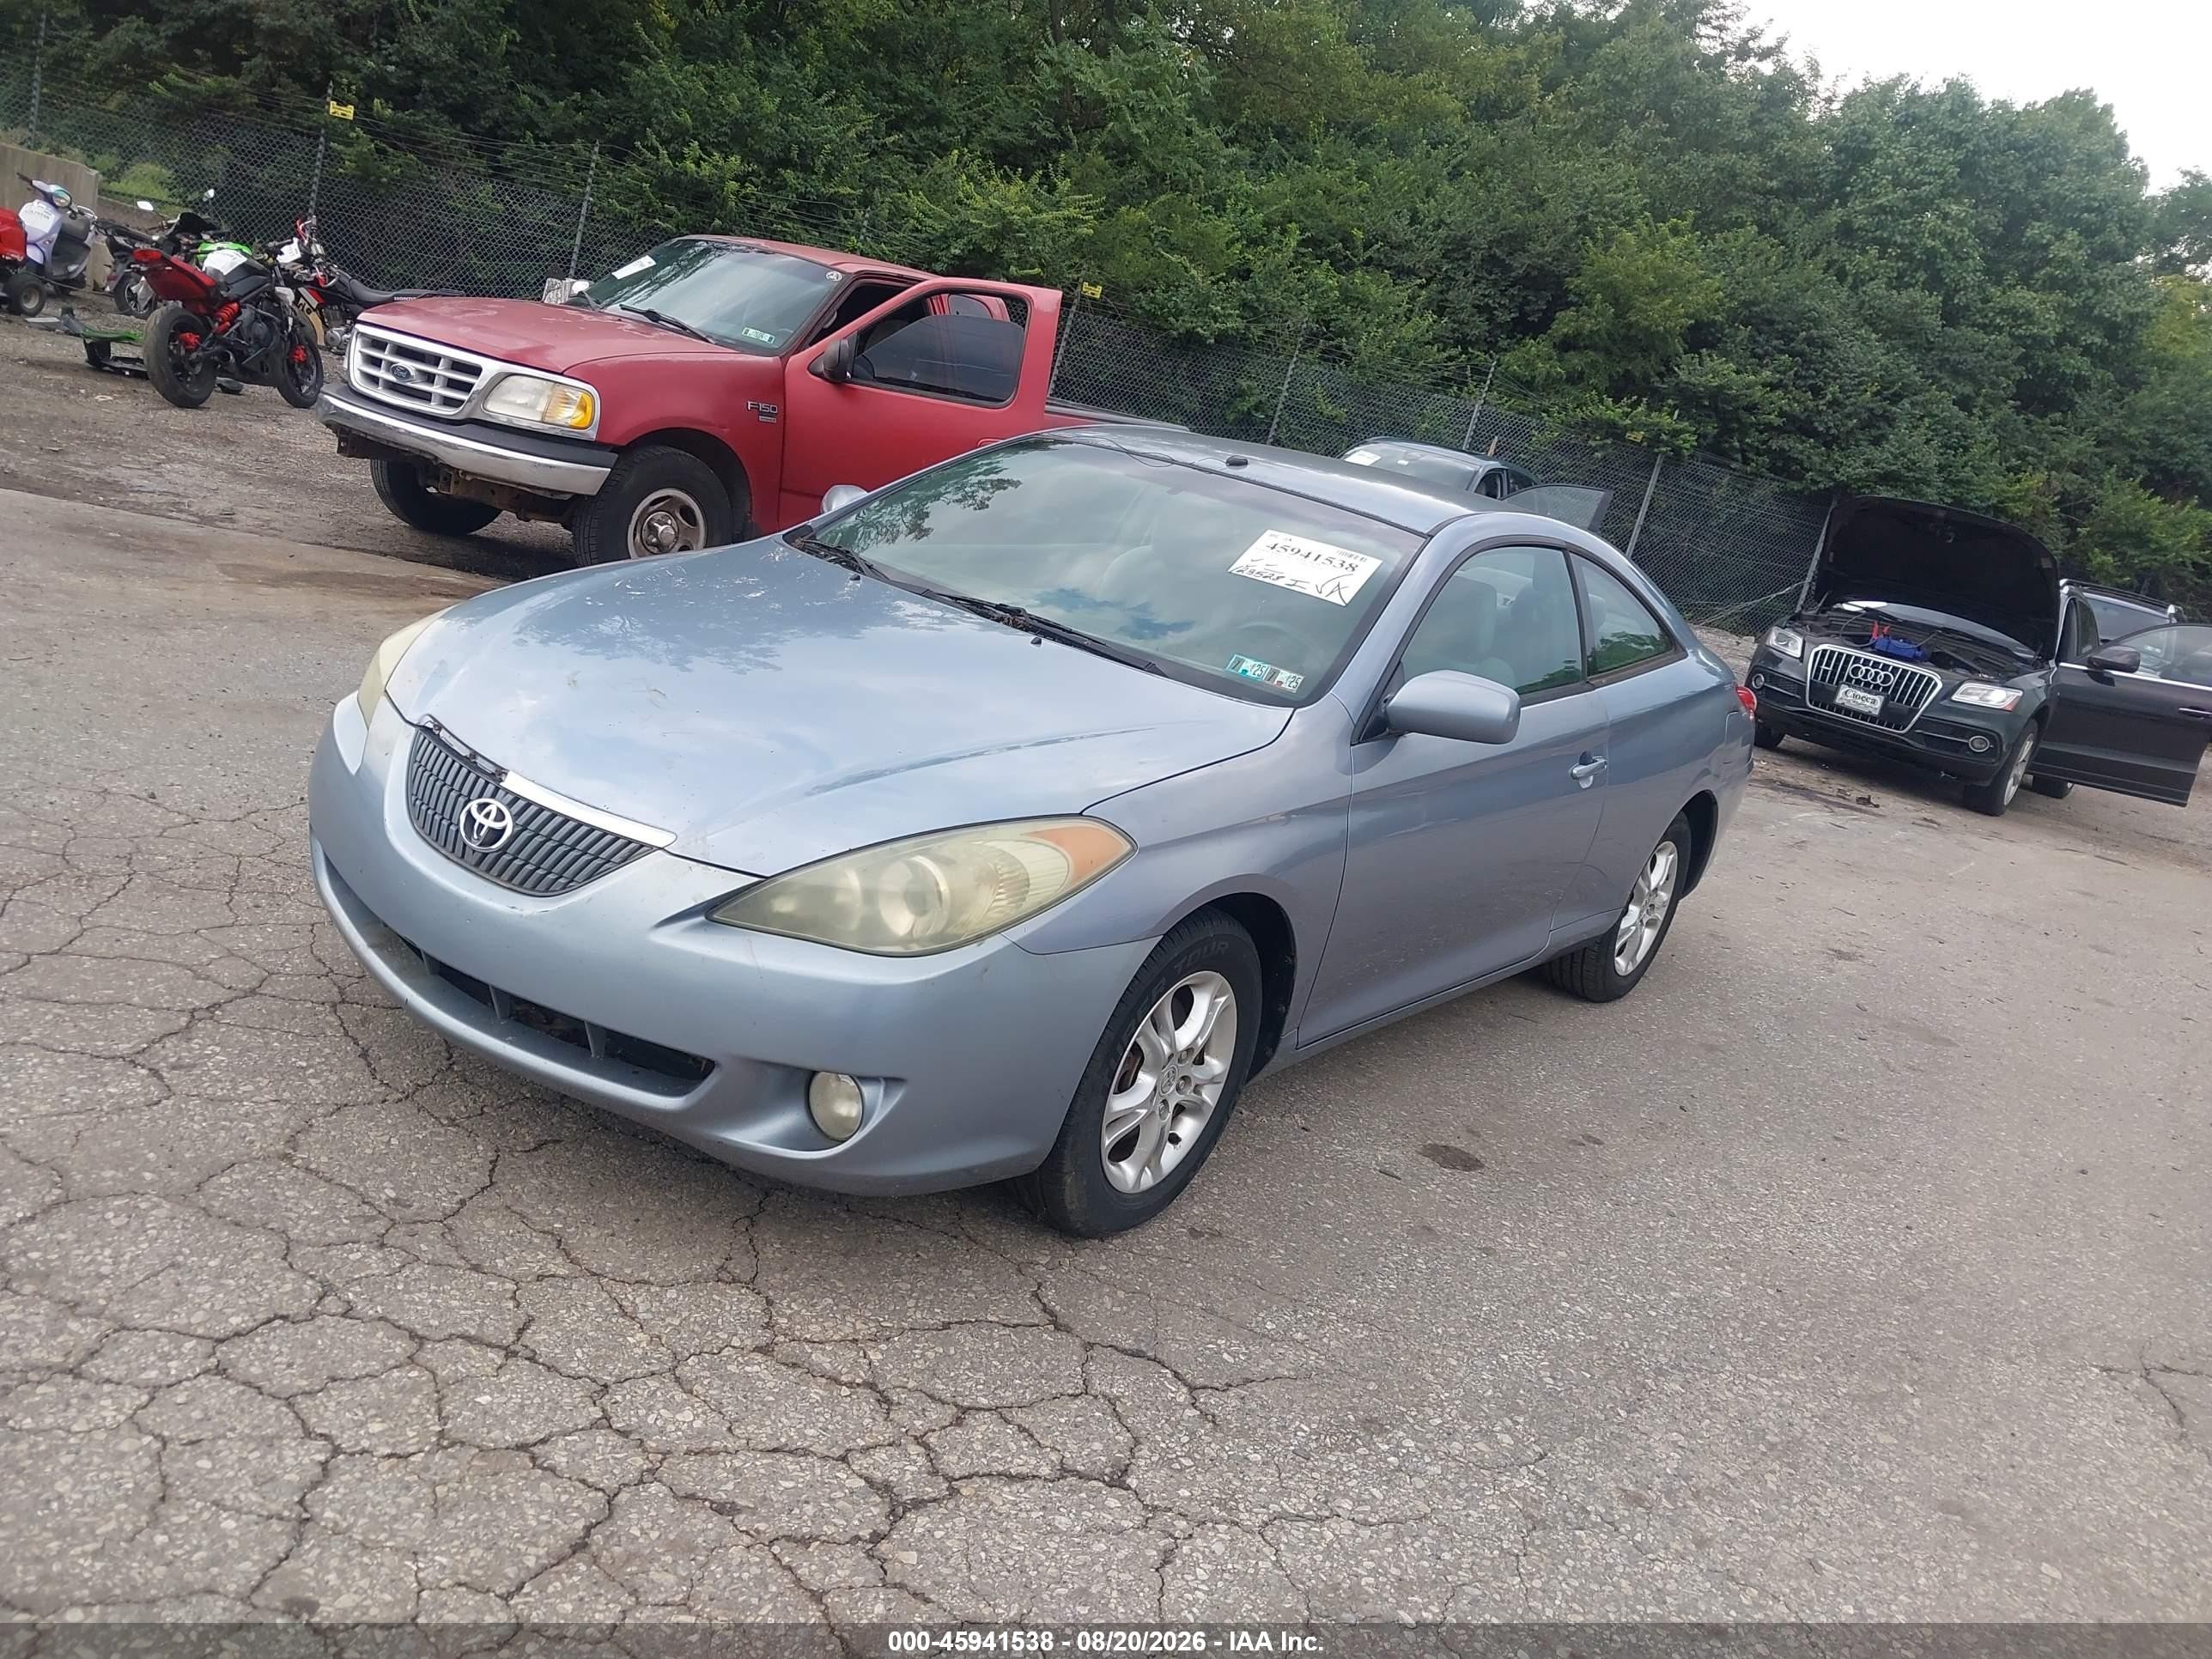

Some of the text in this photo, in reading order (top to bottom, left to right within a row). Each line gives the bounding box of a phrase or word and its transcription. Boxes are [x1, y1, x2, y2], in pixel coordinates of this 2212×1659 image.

[1267, 543, 1359, 573] 45941538
[1252, 664, 1267, 678] 25
[1287, 675, 1302, 689] 25
[1844, 689, 1876, 704] Ciocca
[1174, 940, 1230, 976] TOUR
